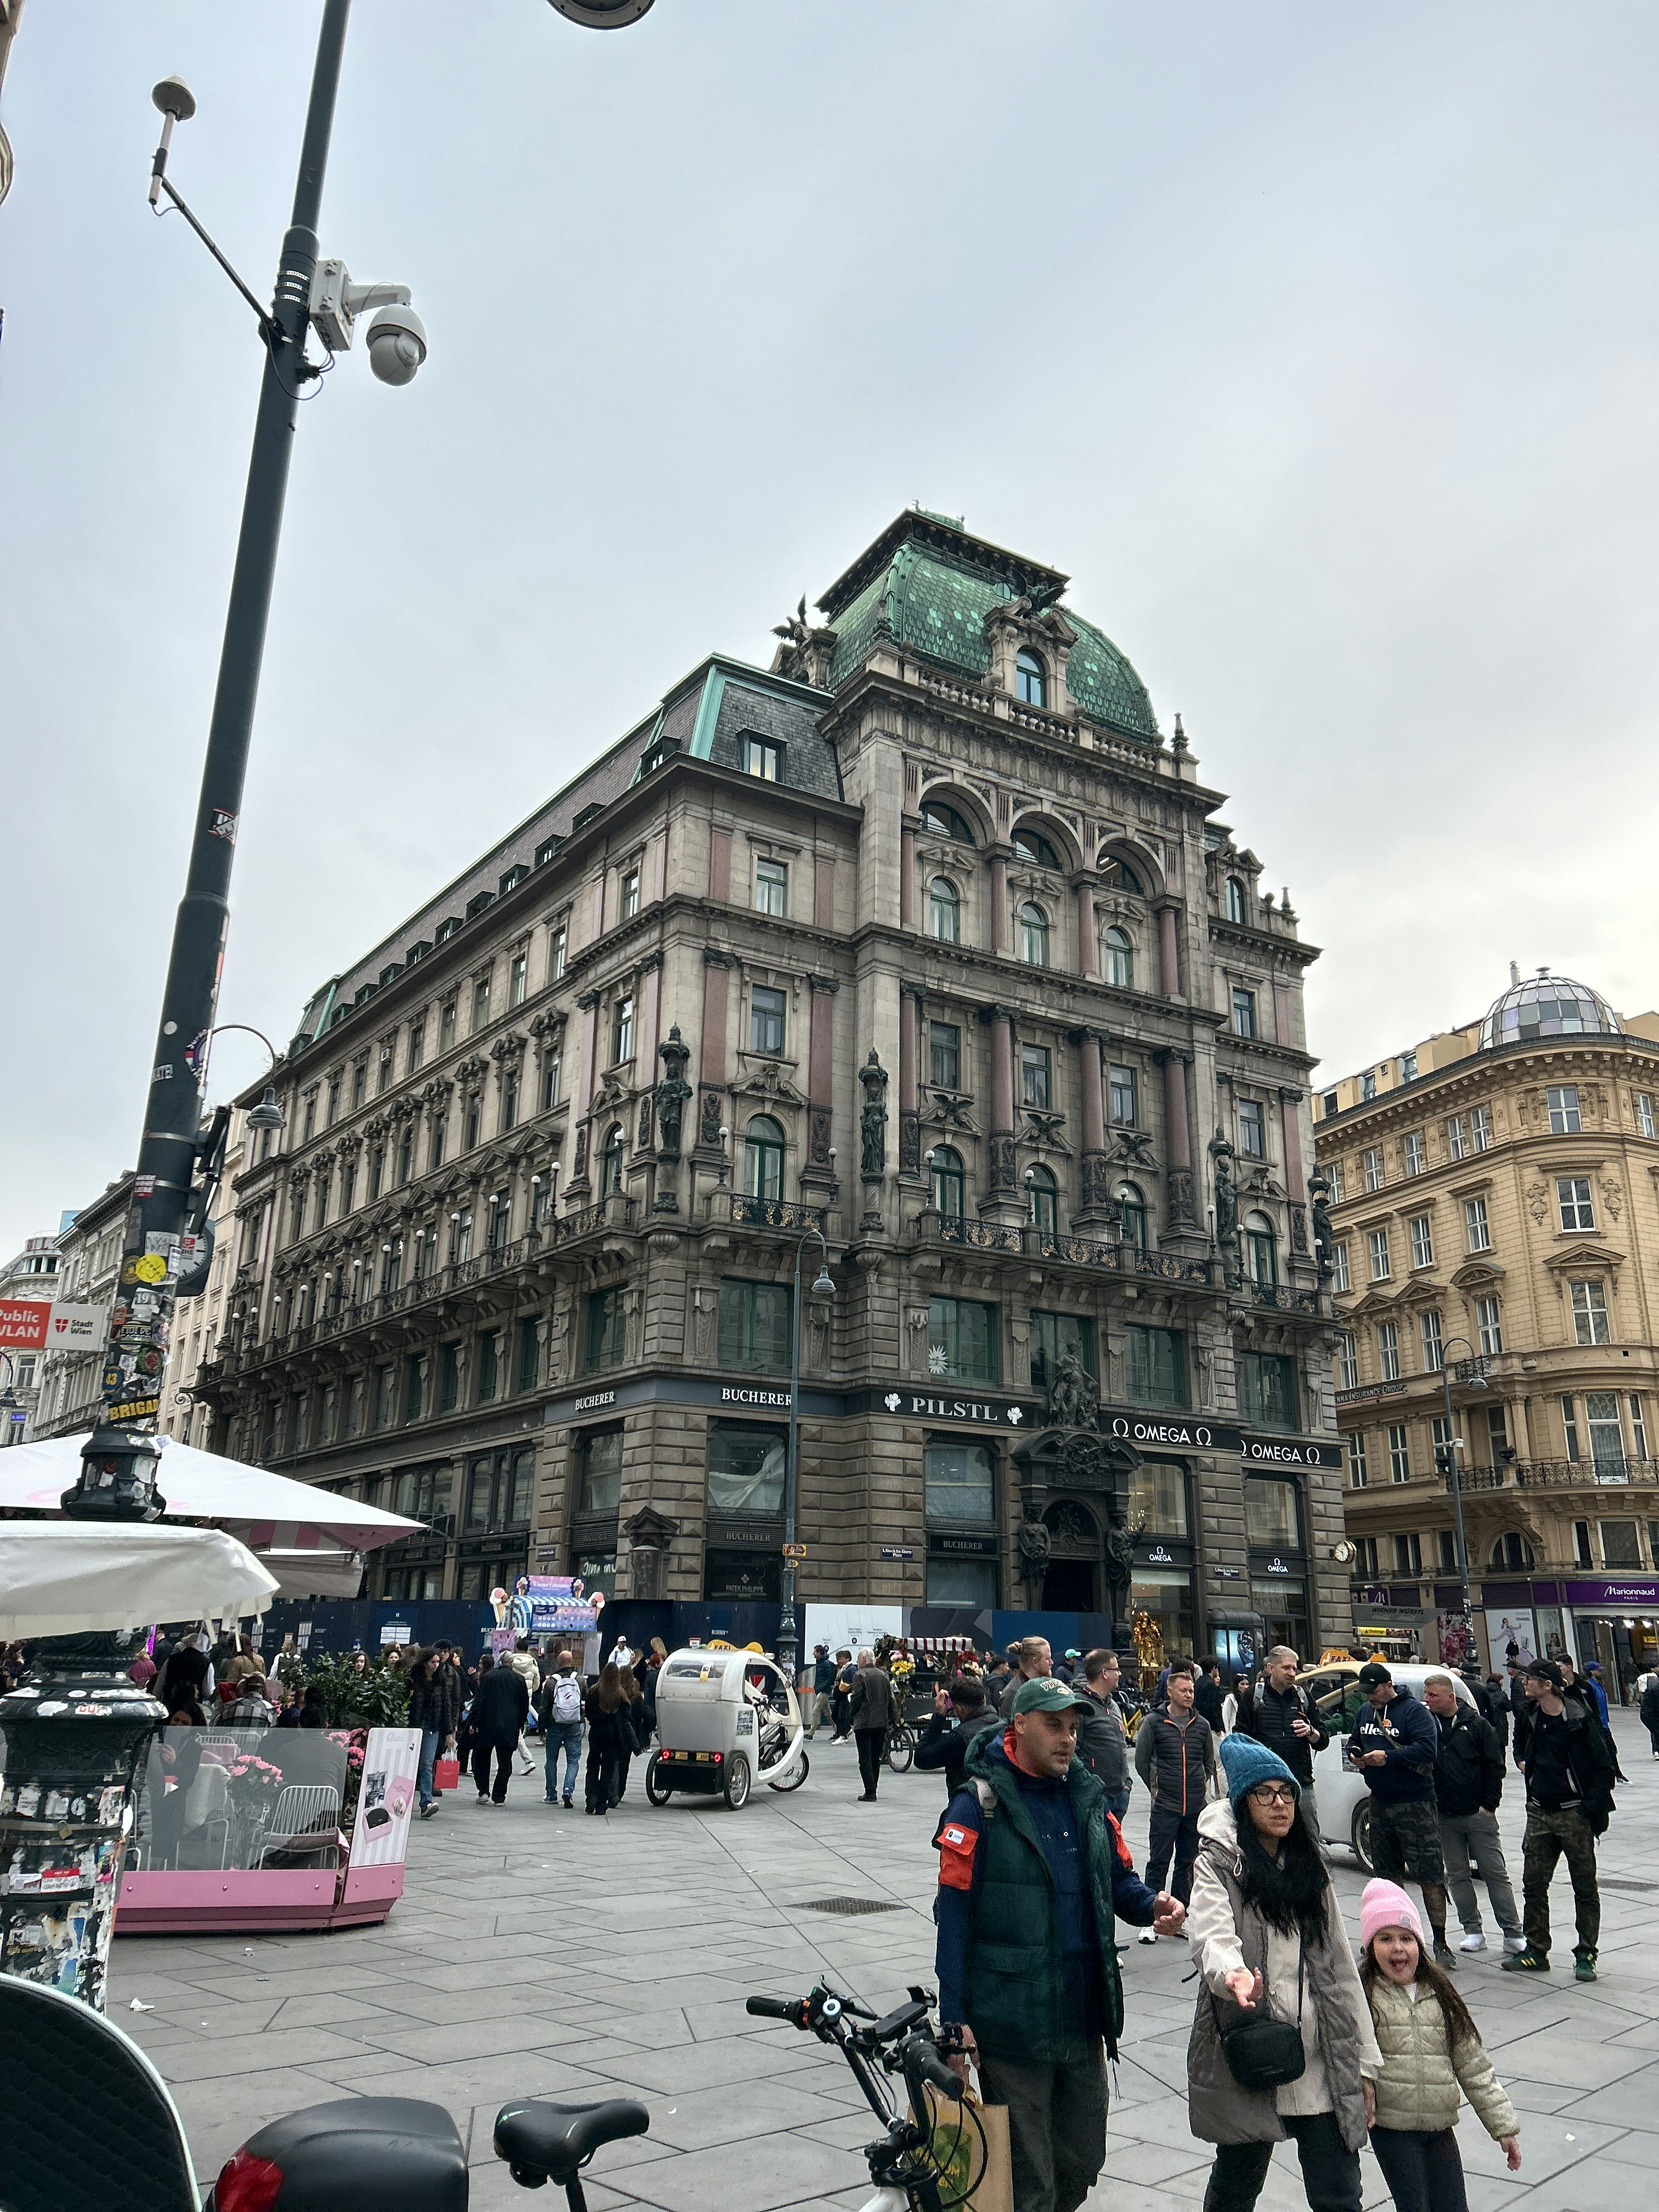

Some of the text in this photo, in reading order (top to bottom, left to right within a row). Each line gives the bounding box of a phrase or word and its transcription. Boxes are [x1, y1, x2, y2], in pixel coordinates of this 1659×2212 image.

[71, 1319, 93, 1328] Stadt
[70, 1327, 92, 1335] Wien
[1382, 1384, 1403, 1393] GROUP
[574, 1391, 614, 1410] BUCHERER
[721, 1387, 792, 1406] BUCHERER
[911, 1397, 998, 1421] PILSTL
[1134, 1424, 1192, 1444] OMEGA
[1251, 1443, 1302, 1463] OMEGA
[726, 1532, 771, 1542] BUCHERER
[943, 1540, 983, 1550] BUCHERER
[1149, 1554, 1172, 1562] OMEGA
[742, 1585, 764, 1593] PHILIPPE
[1604, 1585, 1655, 1598] Marionnaud
